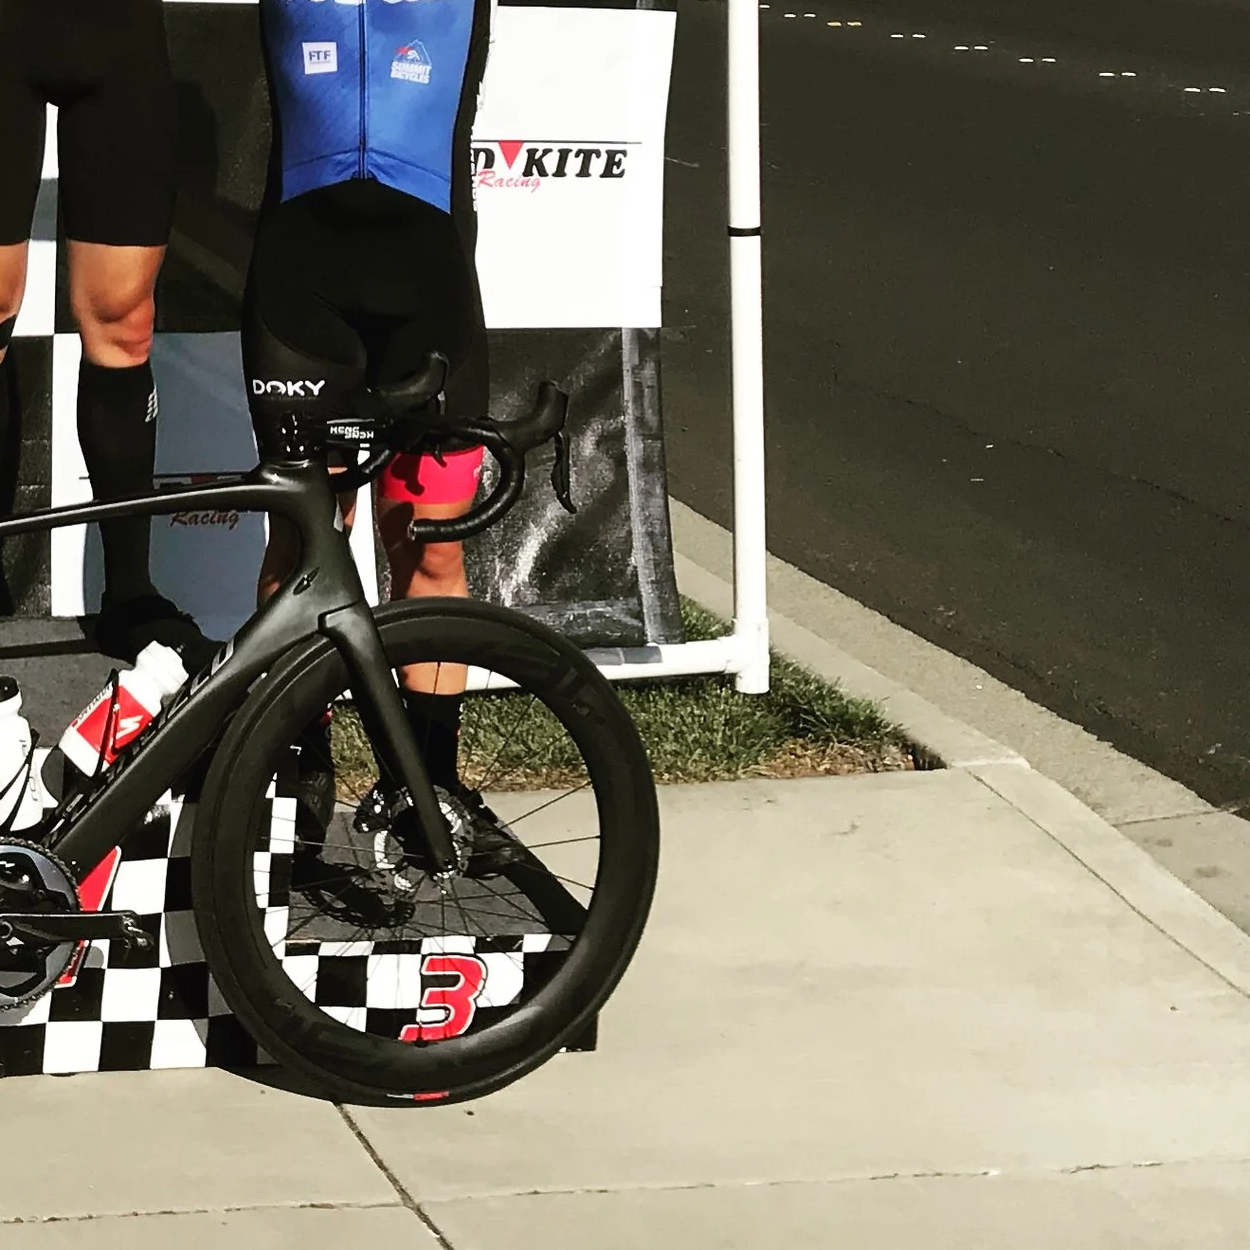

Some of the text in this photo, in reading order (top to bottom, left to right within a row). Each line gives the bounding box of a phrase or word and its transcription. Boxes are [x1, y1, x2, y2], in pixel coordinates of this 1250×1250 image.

[522, 148, 628, 179] KITE
[477, 169, 541, 193] Racing
[398, 953, 488, 1044] 3
